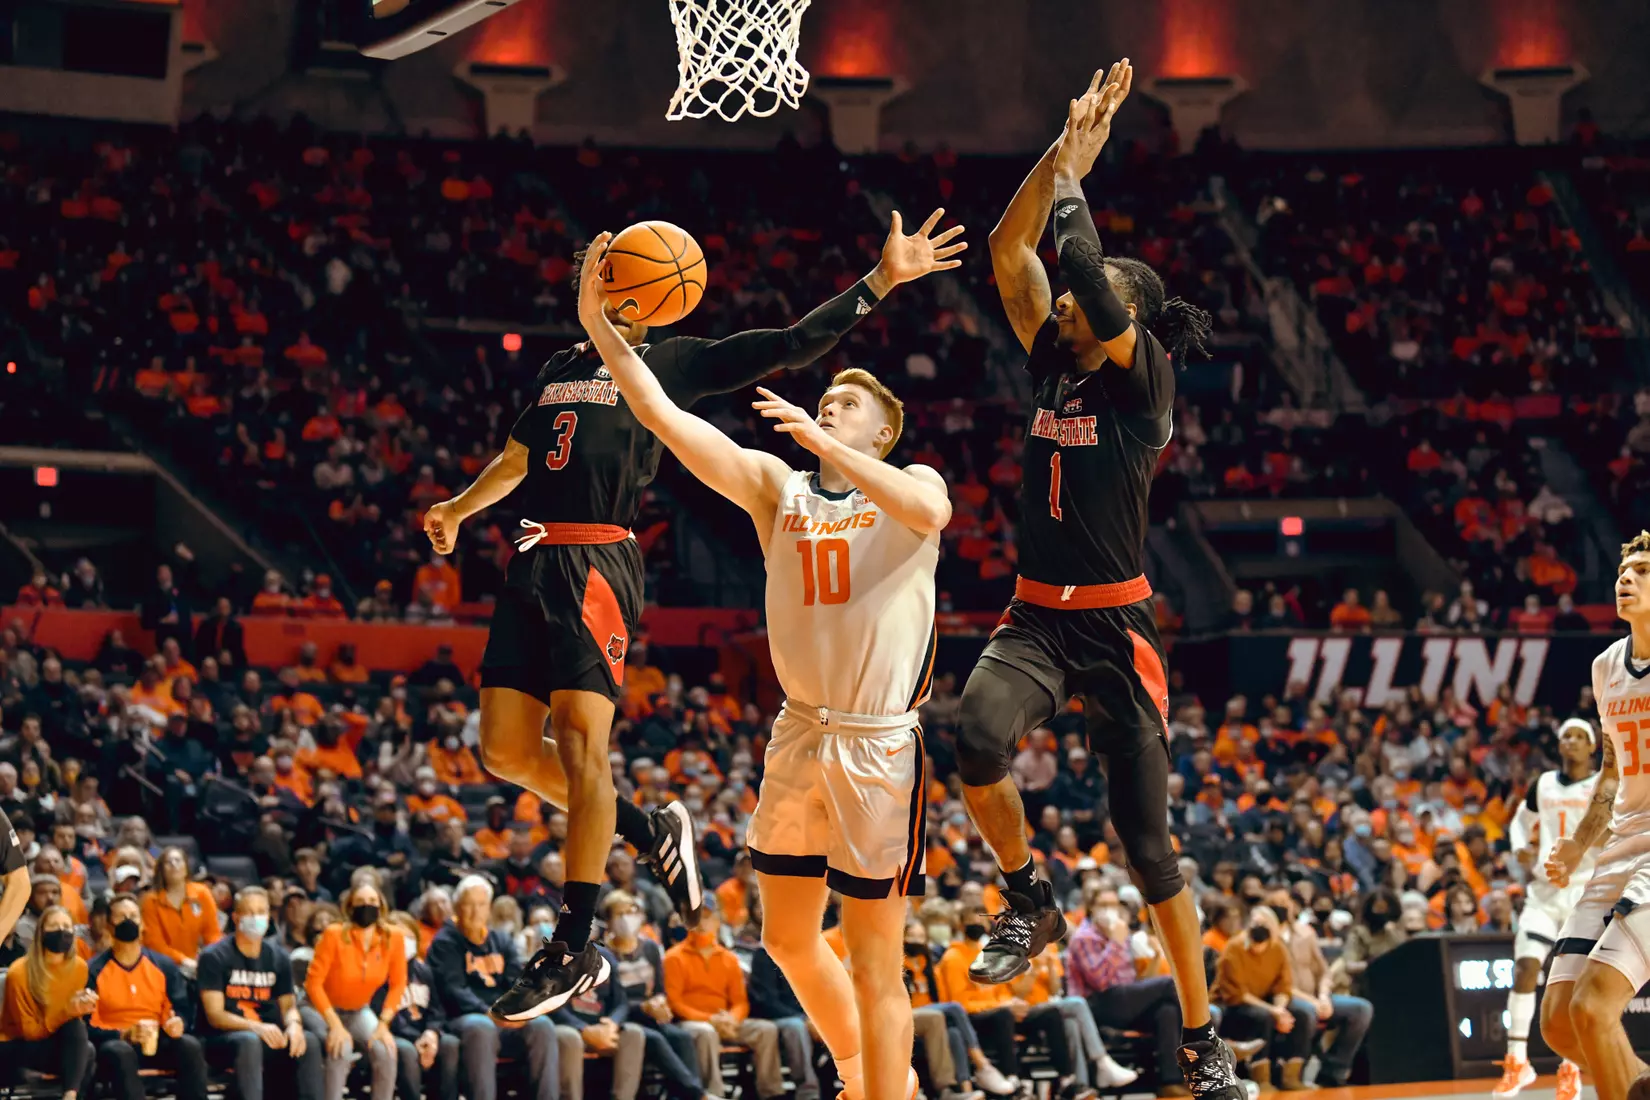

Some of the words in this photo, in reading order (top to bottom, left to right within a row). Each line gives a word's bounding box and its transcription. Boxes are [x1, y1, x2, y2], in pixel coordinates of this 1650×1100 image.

[582, 379, 619, 407] STATE
[546, 411, 578, 470] 3
[1060, 415, 1098, 446] STATE
[1049, 451, 1062, 522] 1
[782, 511, 877, 535] ILLINOIS
[796, 538, 851, 606] 10
[1284, 637, 1549, 708] ILLINI
